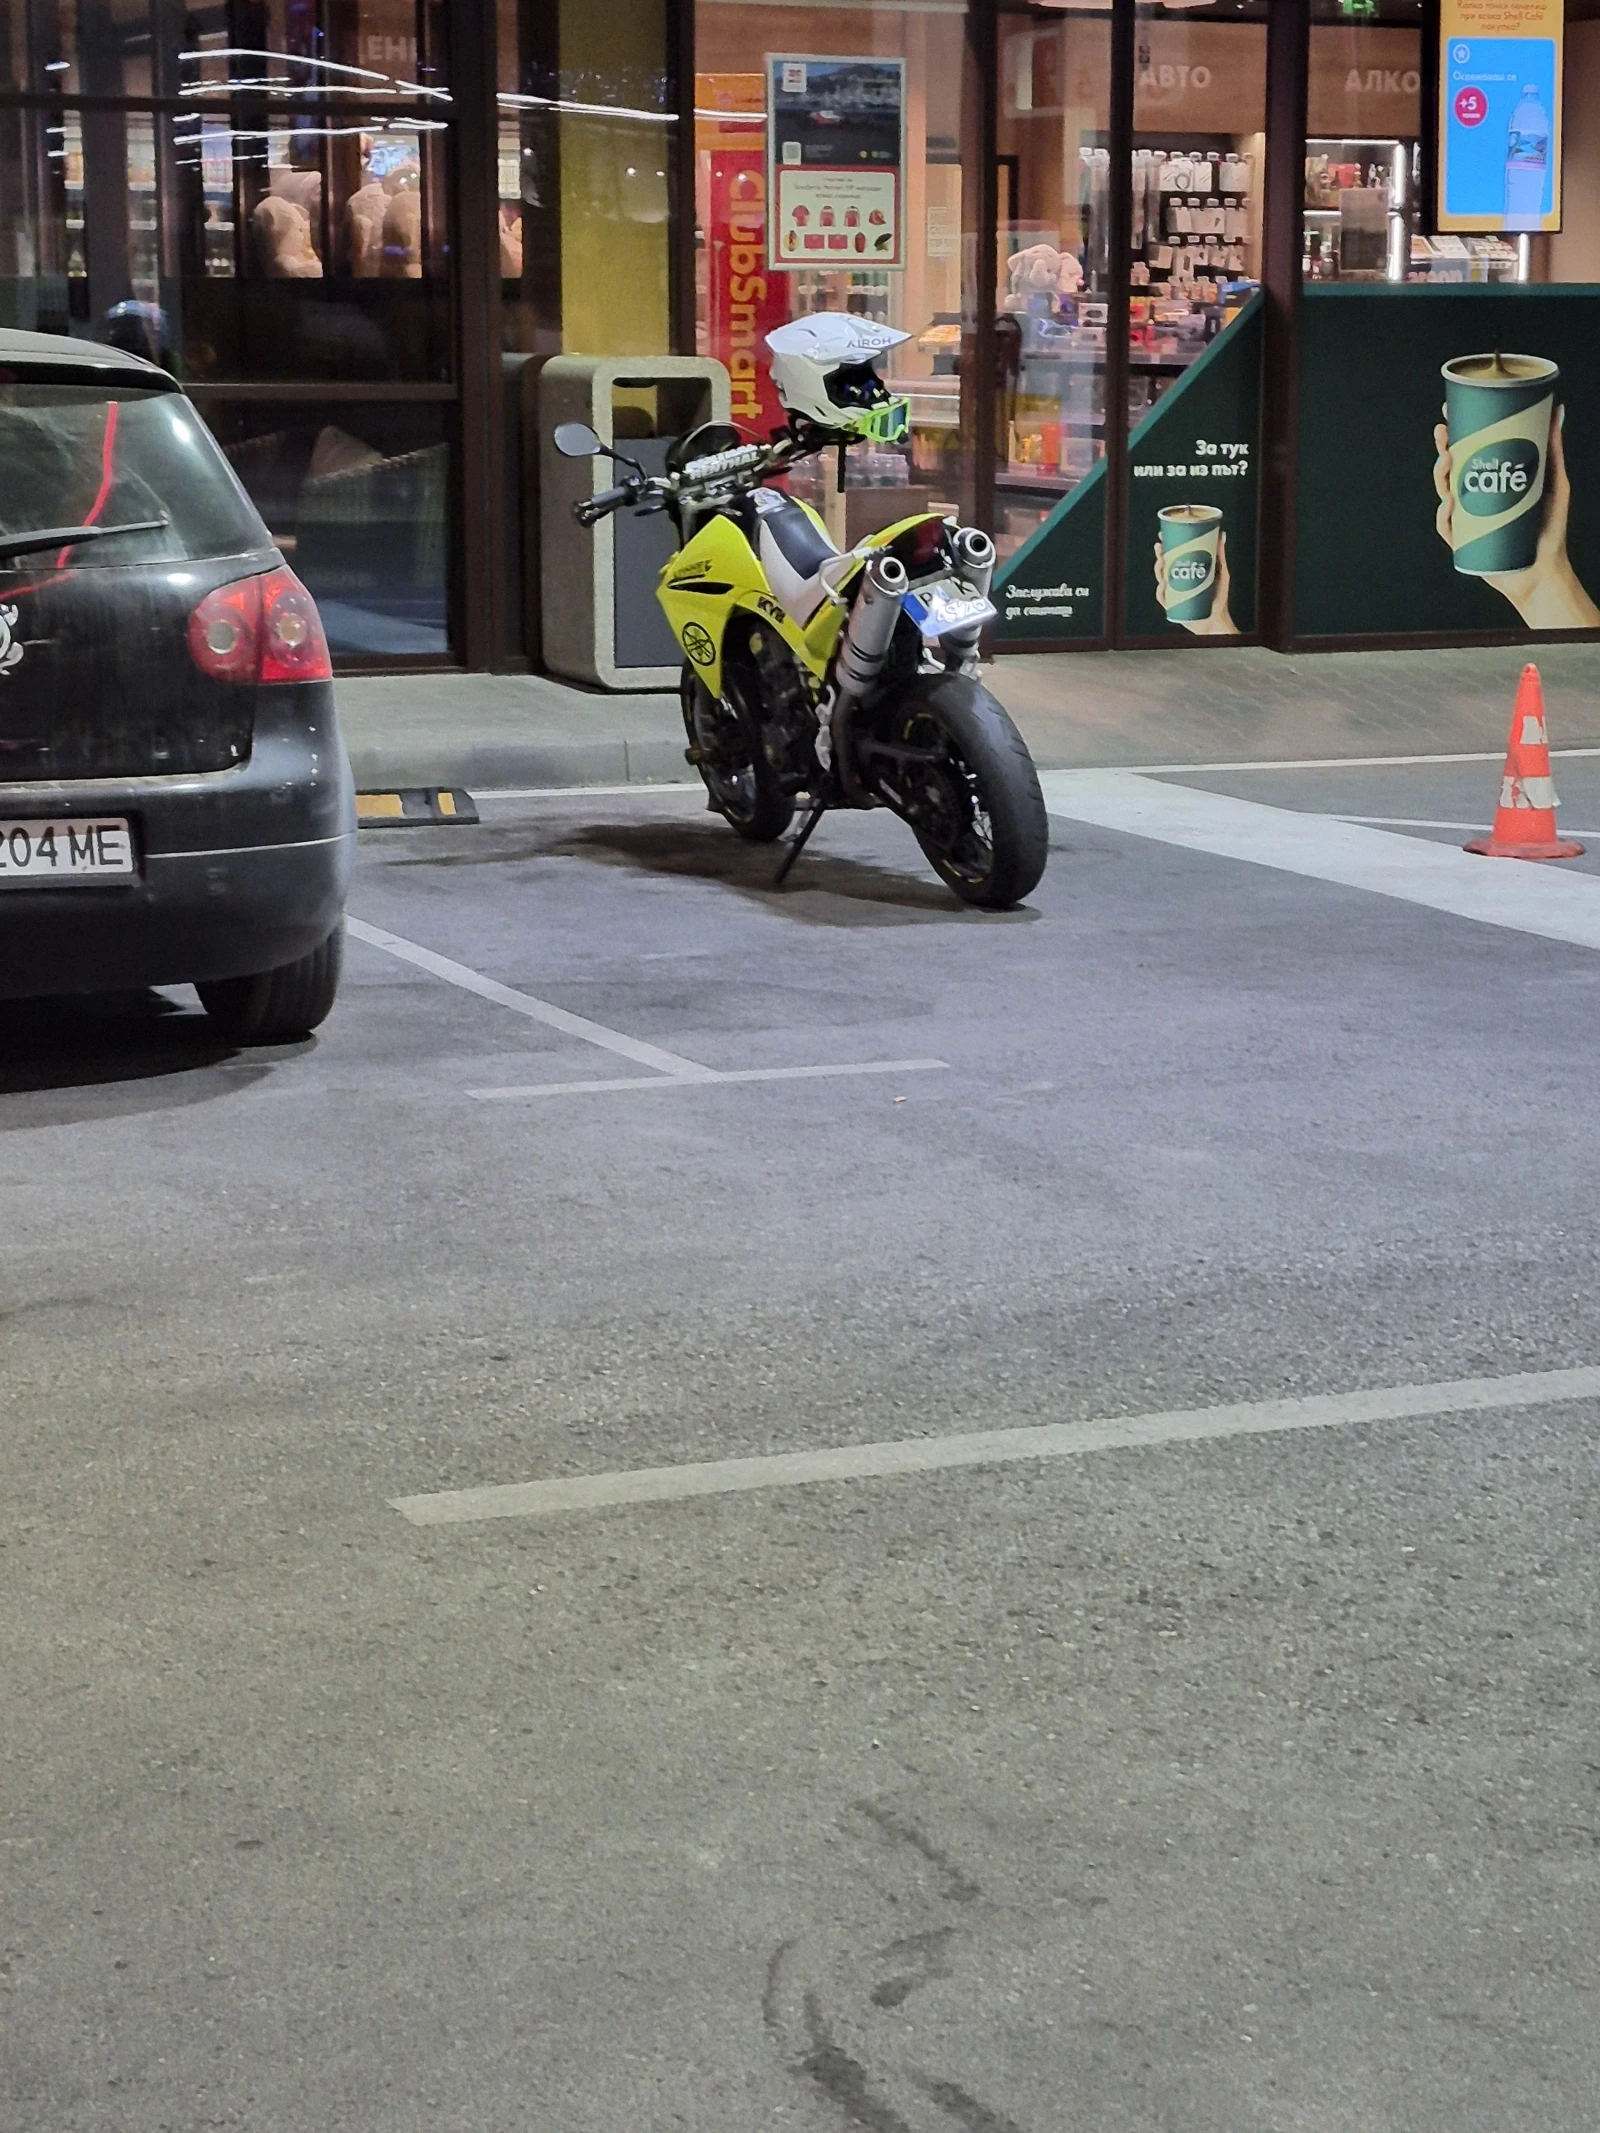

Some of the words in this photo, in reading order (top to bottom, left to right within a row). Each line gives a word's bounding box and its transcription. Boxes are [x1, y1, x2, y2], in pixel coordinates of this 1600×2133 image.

[1138, 64, 1212, 89] АВТО
[1459, 96, 1478, 111] +5
[729, 169, 767, 419] ClubSmart
[846, 337, 892, 348] AIROH
[1195, 439, 1217, 456] За
[1220, 443, 1249, 460] тук
[1133, 465, 1164, 477] или
[1166, 465, 1187, 477] за
[1189, 464, 1209, 477] из
[1211, 460, 1249, 476] път?
[1471, 458, 1499, 470] Shell
[1464, 461, 1527, 493] café
[67, 824, 124, 867] ME
